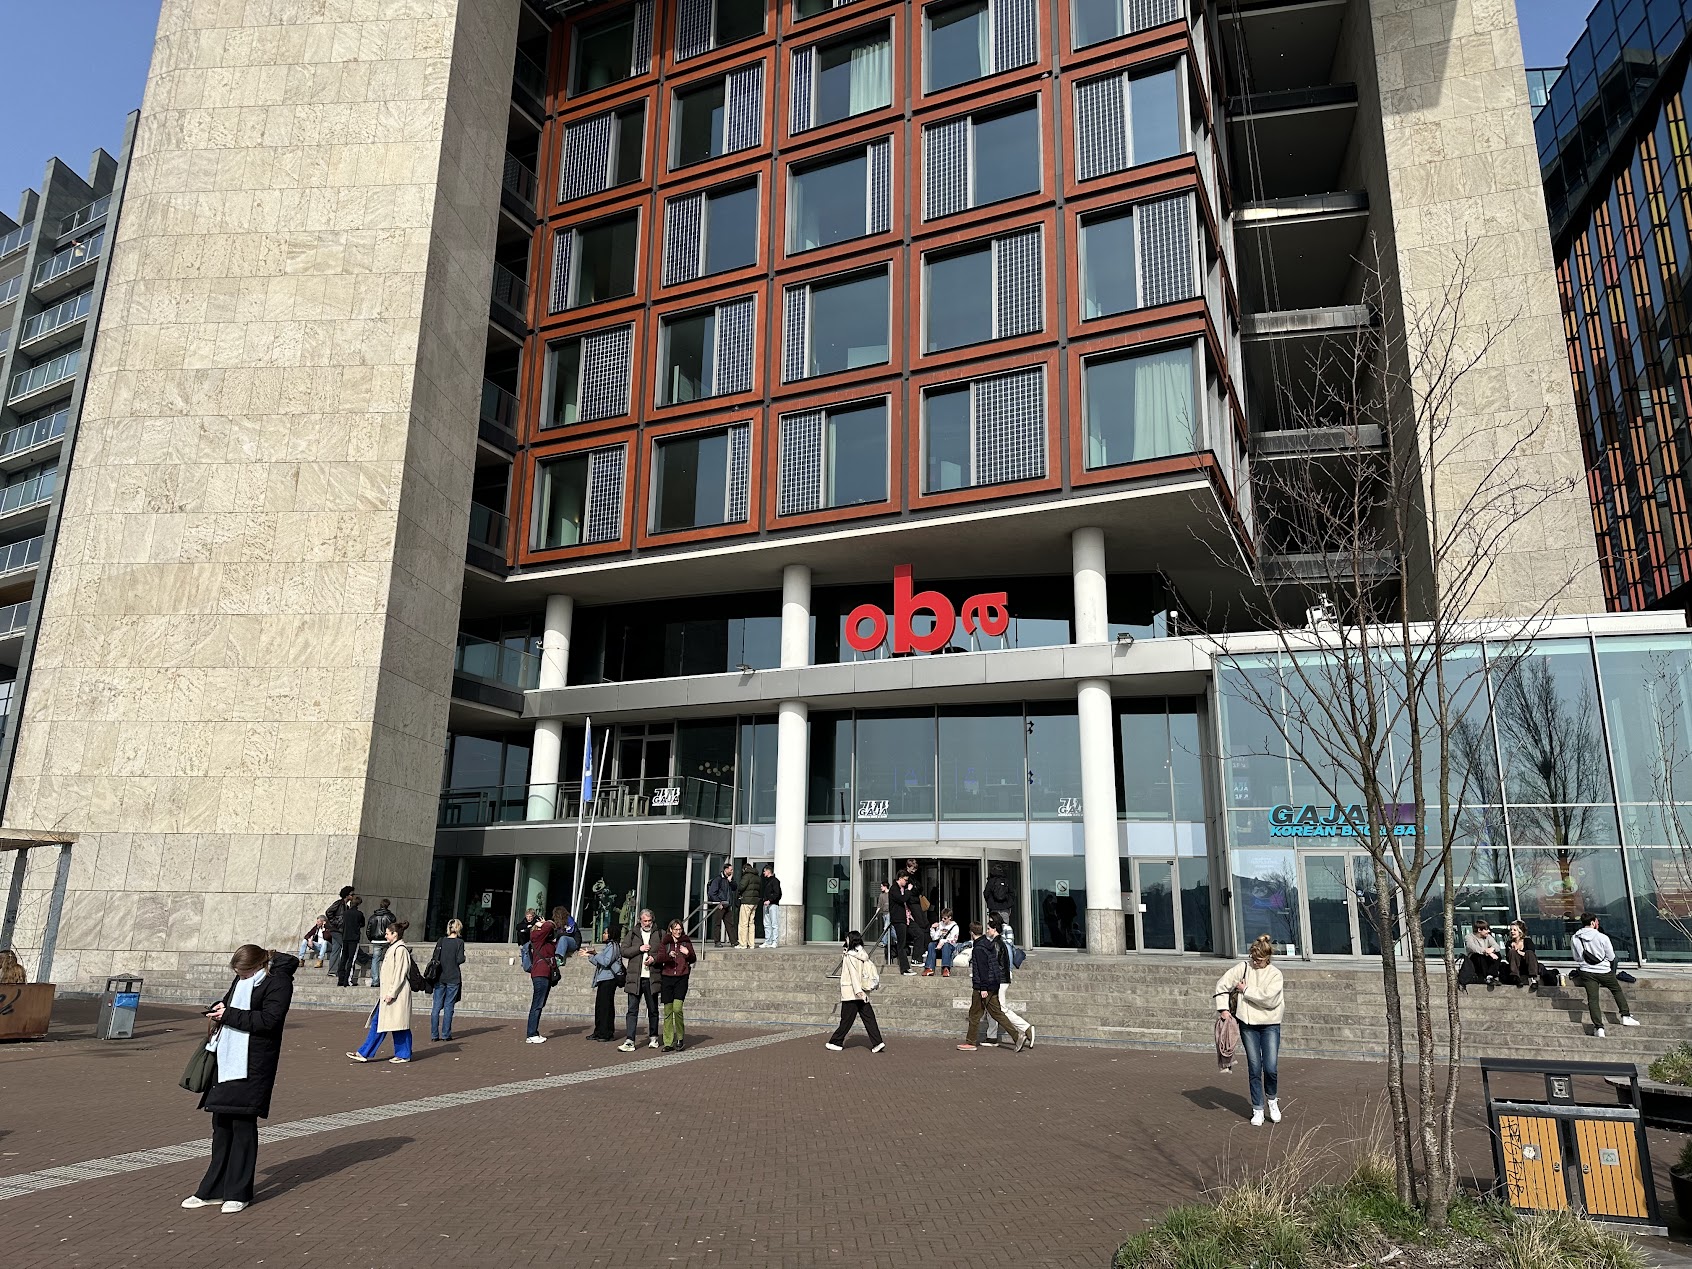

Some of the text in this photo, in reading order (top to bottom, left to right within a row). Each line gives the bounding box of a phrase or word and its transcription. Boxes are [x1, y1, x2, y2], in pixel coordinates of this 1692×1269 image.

[845, 564, 1009, 653] oba
[652, 796, 679, 804] GAJA
[858, 808, 888, 816] GAJA
[1268, 803, 1368, 825] GAJA
[1271, 825, 1337, 837] KOREAN
